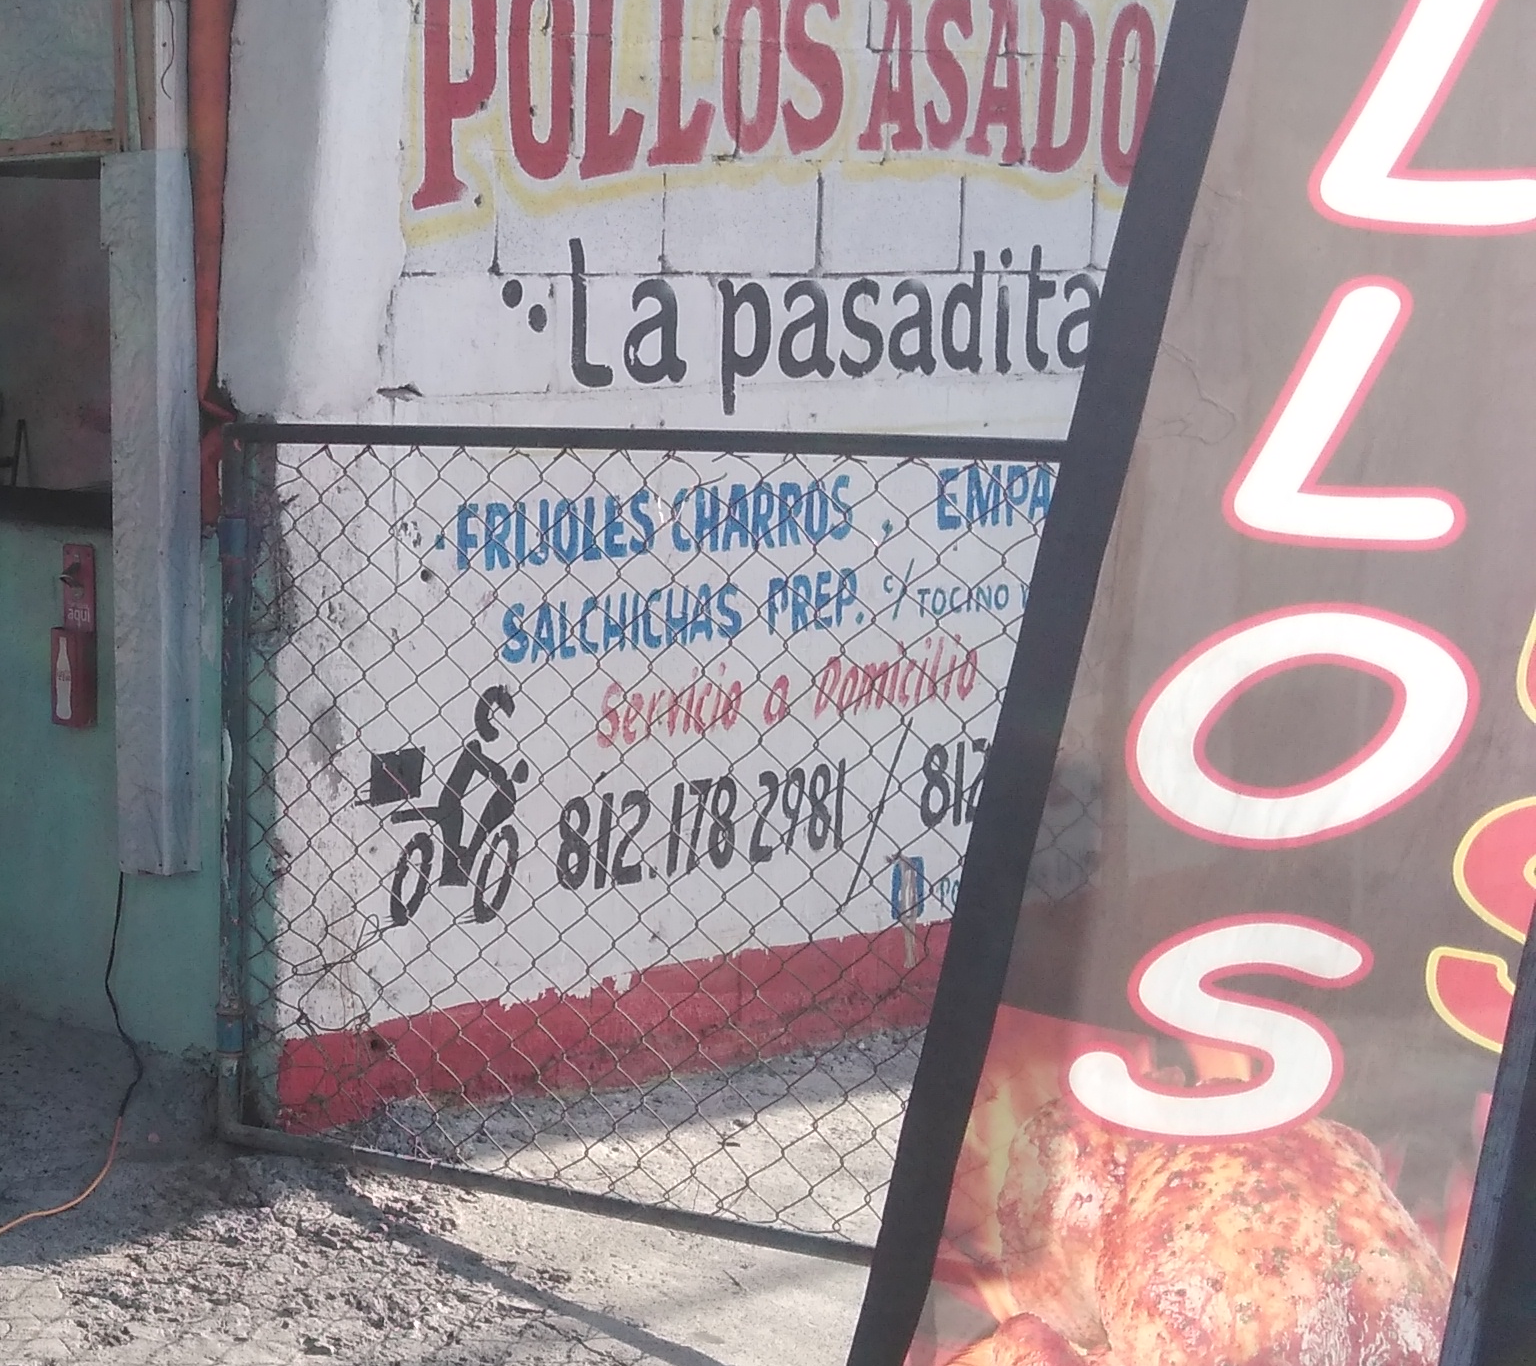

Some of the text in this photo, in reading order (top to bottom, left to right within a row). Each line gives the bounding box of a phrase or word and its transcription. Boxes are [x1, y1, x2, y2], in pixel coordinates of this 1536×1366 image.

[568, 238, 1102, 416] La pasadita
[456, 489, 656, 571] FRIJOLES
[500, 583, 743, 664] SALCHICHAS
[768, 567, 864, 636] PREP.
[916, 584, 1010, 618] TOCINO
[597, 634, 978, 749] Servicio a Domicilio
[748, 758, 847, 863] 2981
